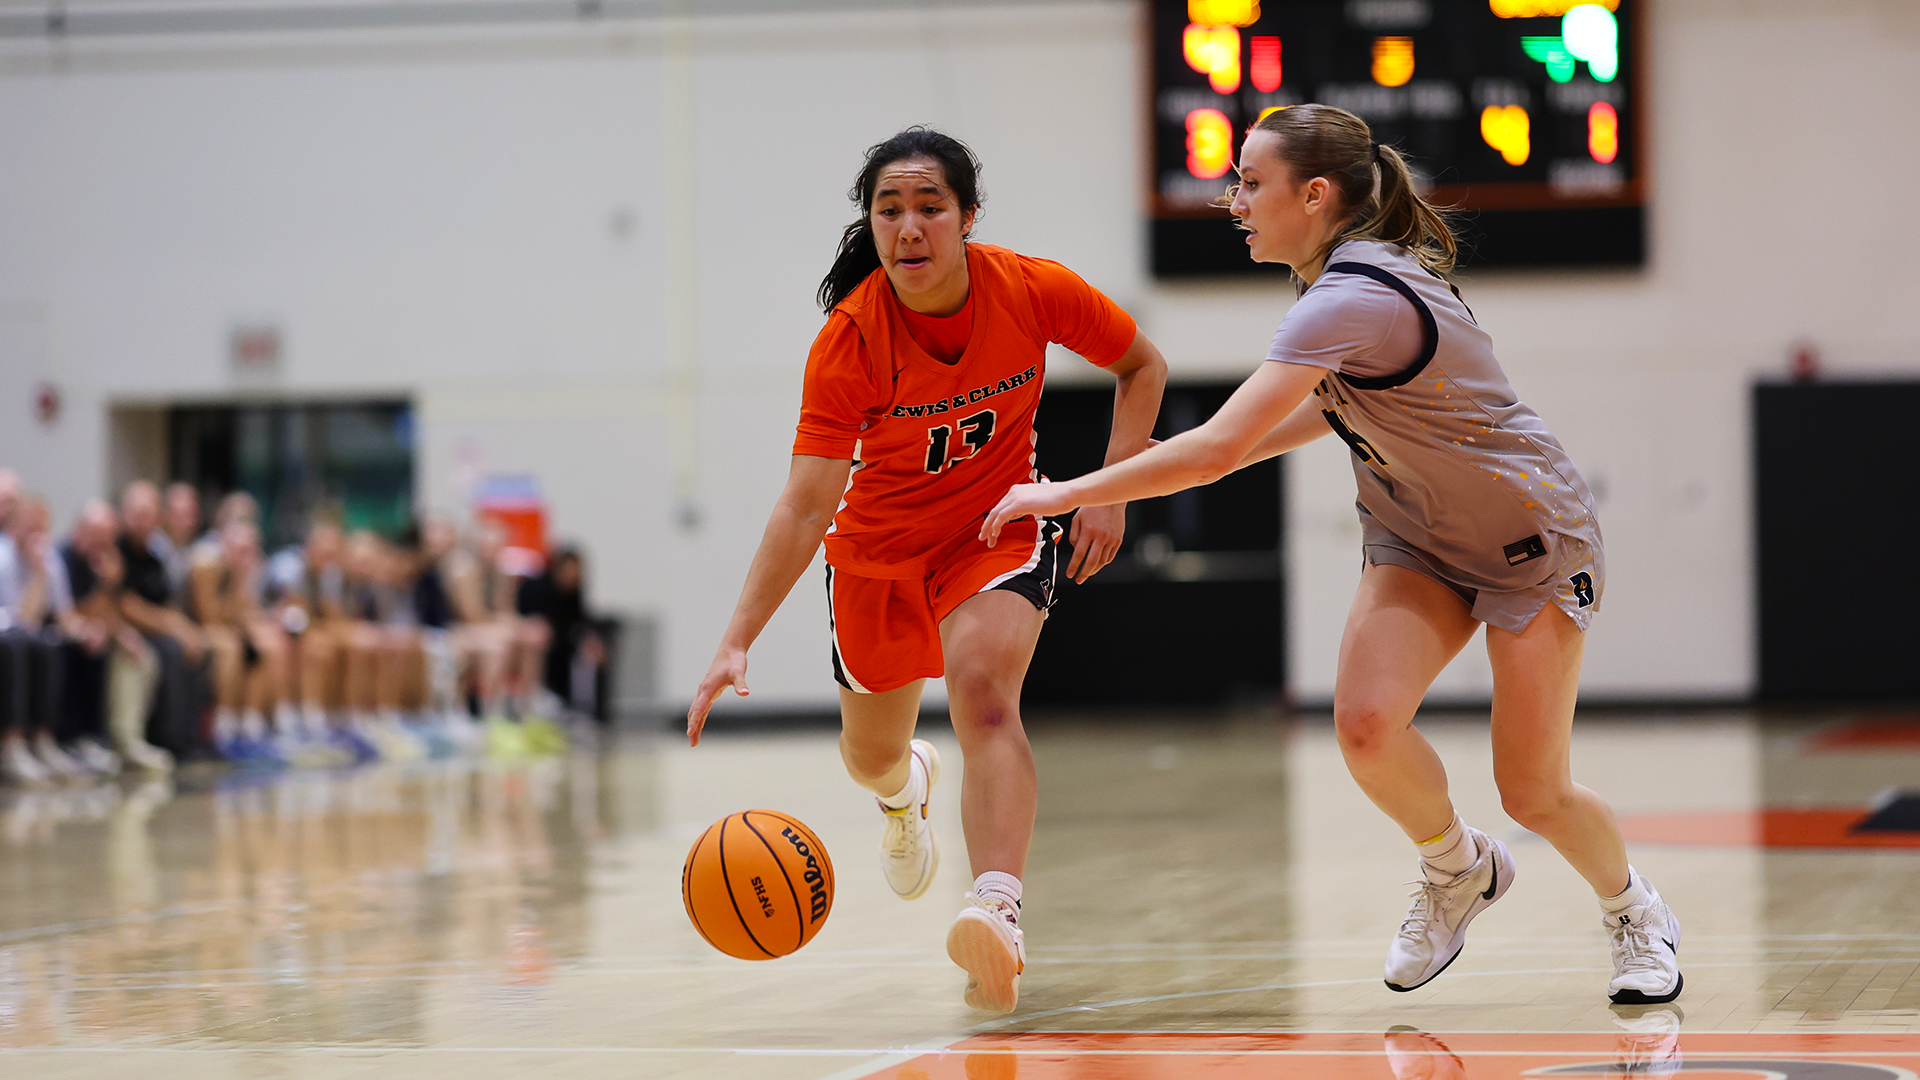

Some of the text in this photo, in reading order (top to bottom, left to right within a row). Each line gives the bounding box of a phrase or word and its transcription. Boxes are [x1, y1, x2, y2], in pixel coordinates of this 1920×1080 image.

[952, 394, 967, 409] &
[968, 365, 1038, 404] CLARK
[923, 408, 998, 475] 13
[751, 876, 773, 910] NFHS
[781, 826, 828, 925] Wilson
